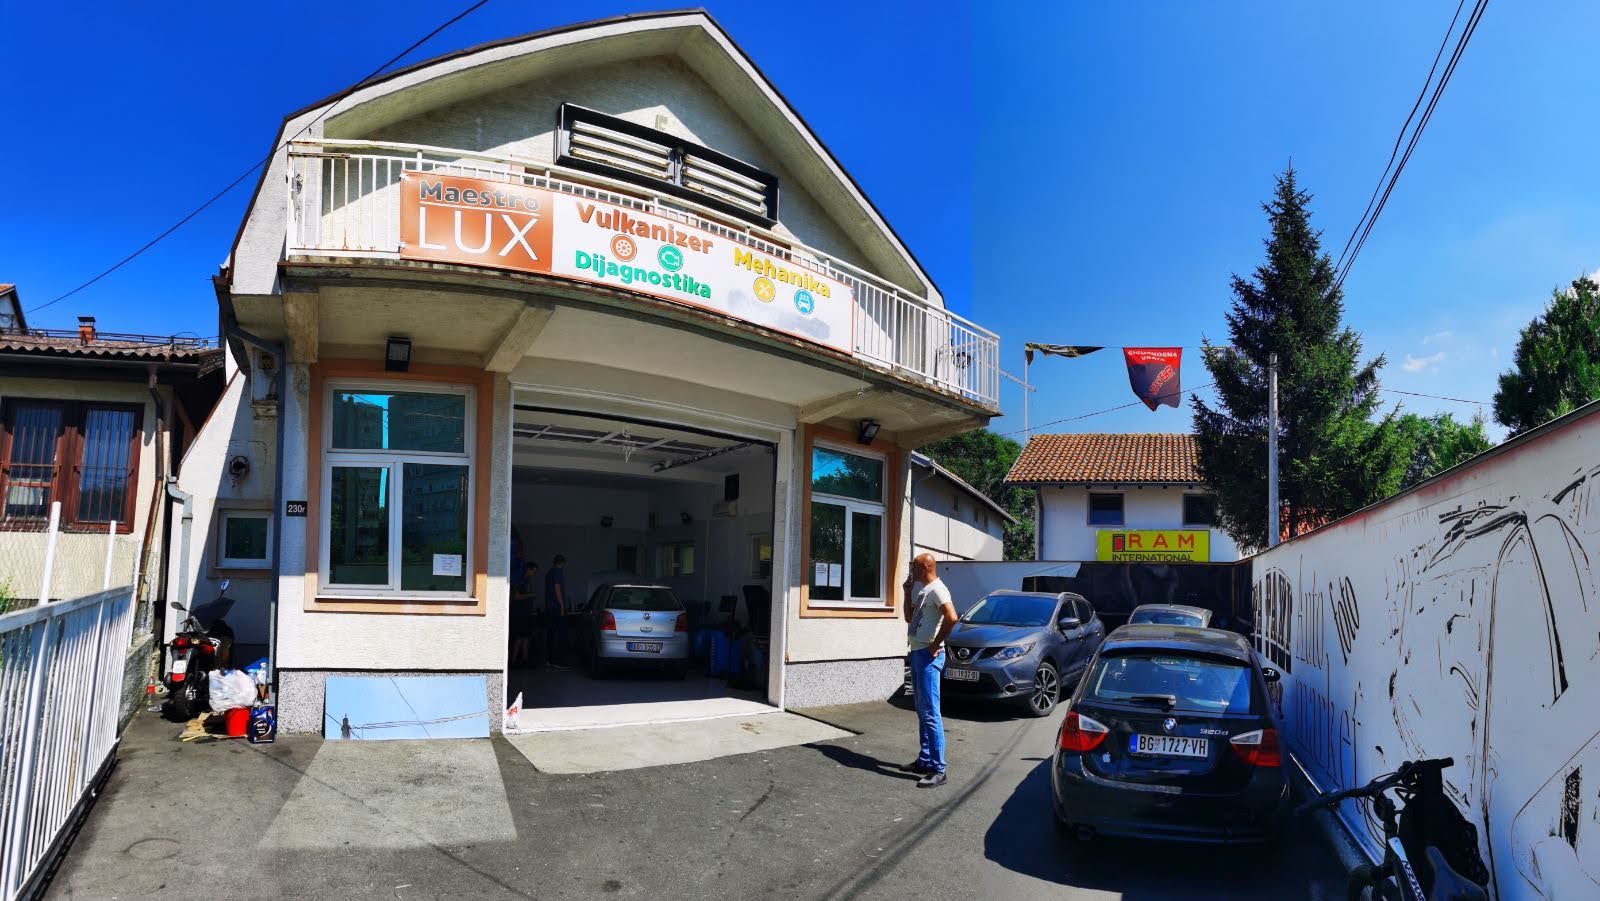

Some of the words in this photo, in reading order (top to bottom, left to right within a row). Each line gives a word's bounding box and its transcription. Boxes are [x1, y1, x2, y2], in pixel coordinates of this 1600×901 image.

[419, 180, 540, 211] Maestro
[418, 206, 539, 261] LUX
[576, 201, 714, 254] Vulkanizer
[575, 249, 712, 299] Dijagnostika
[734, 247, 831, 299] Mehanika
[1112, 553, 1195, 562] INTERNATIONAL
[1128, 533, 1196, 549] RAM
[1296, 553, 1324, 670] Auto
[1329, 575, 1360, 667] foto
[1139, 735, 1154, 751] BG
[1200, 728, 1230, 736] 320d
